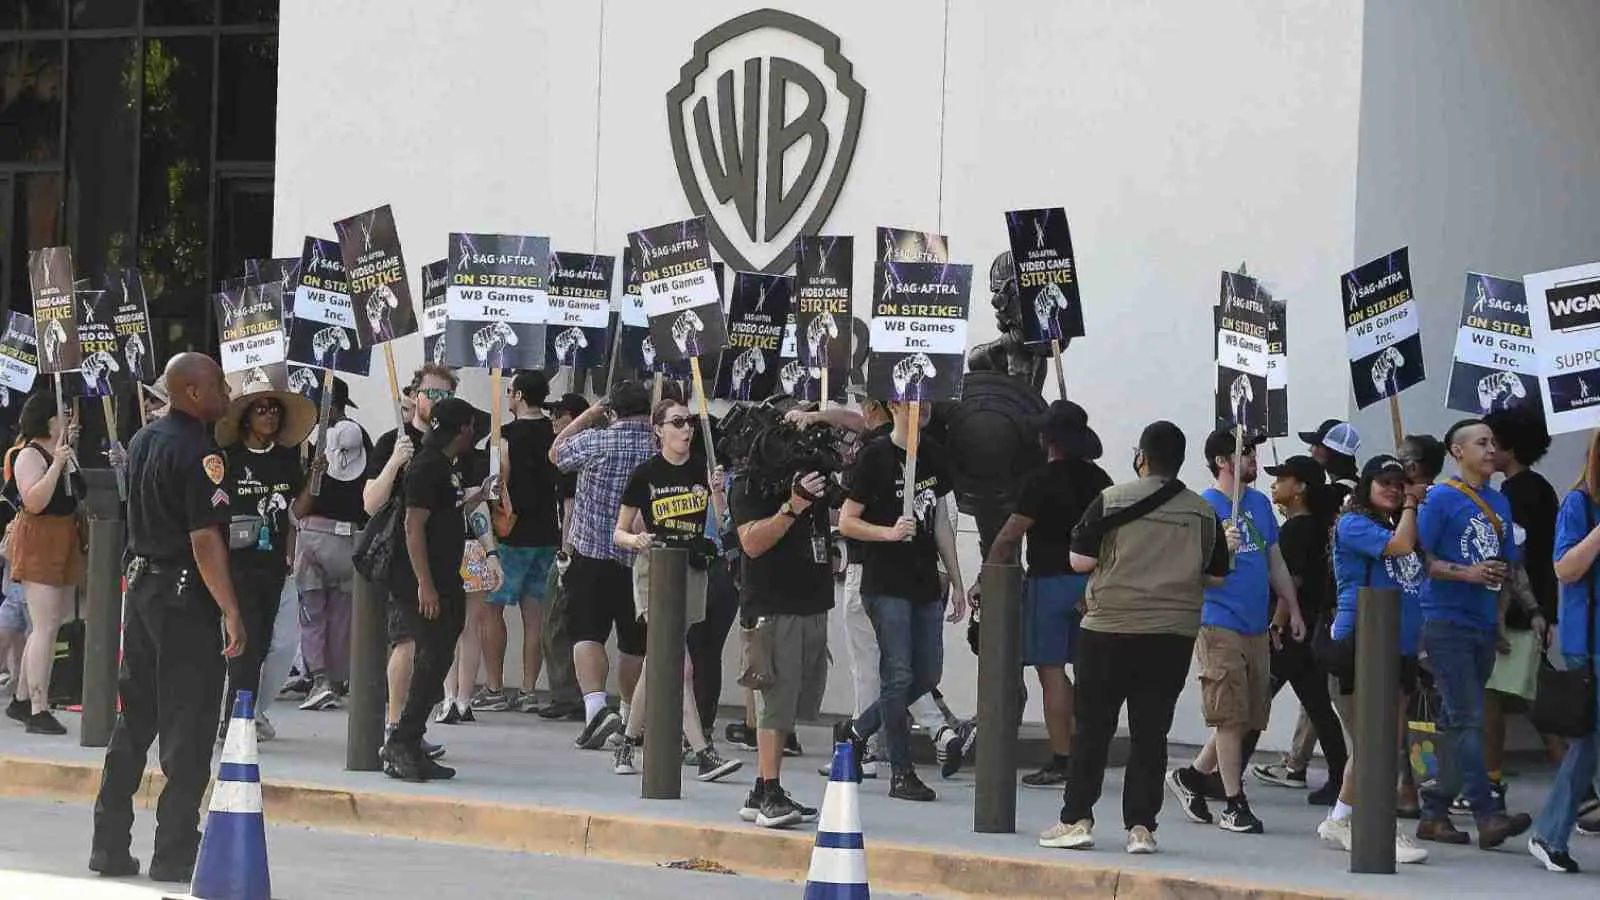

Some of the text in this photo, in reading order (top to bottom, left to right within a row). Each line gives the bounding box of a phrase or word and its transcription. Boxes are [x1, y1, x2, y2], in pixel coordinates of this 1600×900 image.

[693, 56, 829, 243] WB
[350, 256, 400, 279] VIDEO GAME
[642, 259, 708, 281] ON STRIKE!
[1019, 258, 1072, 272] VIDEO GAME
[303, 275, 349, 293] ON STR
[352, 267, 402, 294] STRIKE
[454, 274, 474, 285] ON
[479, 275, 542, 288] STRIKE!
[650, 275, 705, 295] WB Games
[1020, 271, 1073, 288] STRIKE
[307, 290, 326, 302] WB
[460, 290, 534, 304] WB Games
[558, 287, 607, 298] STRIKE!
[800, 288, 848, 298] VIDEO GAME
[549, 297, 600, 311] WB Games
[671, 294, 692, 306] Inc.
[800, 299, 848, 313] STRIKE
[1349, 289, 1409, 325] ON STRIKE!
[1549, 294, 1600, 318] WGA
[37, 306, 72, 322] STRIKE
[324, 308, 346, 321] Inc.
[482, 305, 510, 317] Inc.
[564, 312, 583, 322] Inc.
[877, 304, 962, 316] ON STRIKE!
[115, 321, 146, 336] STRIKE
[732, 323, 758, 334] VIDEO
[758, 325, 782, 335] GAME
[885, 321, 955, 333] WB Games
[1222, 318, 1234, 330] ON
[1235, 321, 1266, 338] STRIKE!
[1356, 308, 1408, 338] WB Games
[1466, 316, 1487, 329] ON
[224, 320, 278, 340] ON STRIKE!
[229, 336, 275, 353] WB Games
[730, 333, 780, 350] STRIKE
[905, 337, 930, 348] Inc.
[1225, 334, 1238, 346] WB
[1239, 337, 1262, 353] Games
[1375, 334, 1395, 346] Inc.
[1472, 333, 1536, 354] WB Gam
[246, 353, 262, 364] Inc.
[1236, 353, 1250, 366] Inc.
[1493, 353, 1520, 367] Inc.
